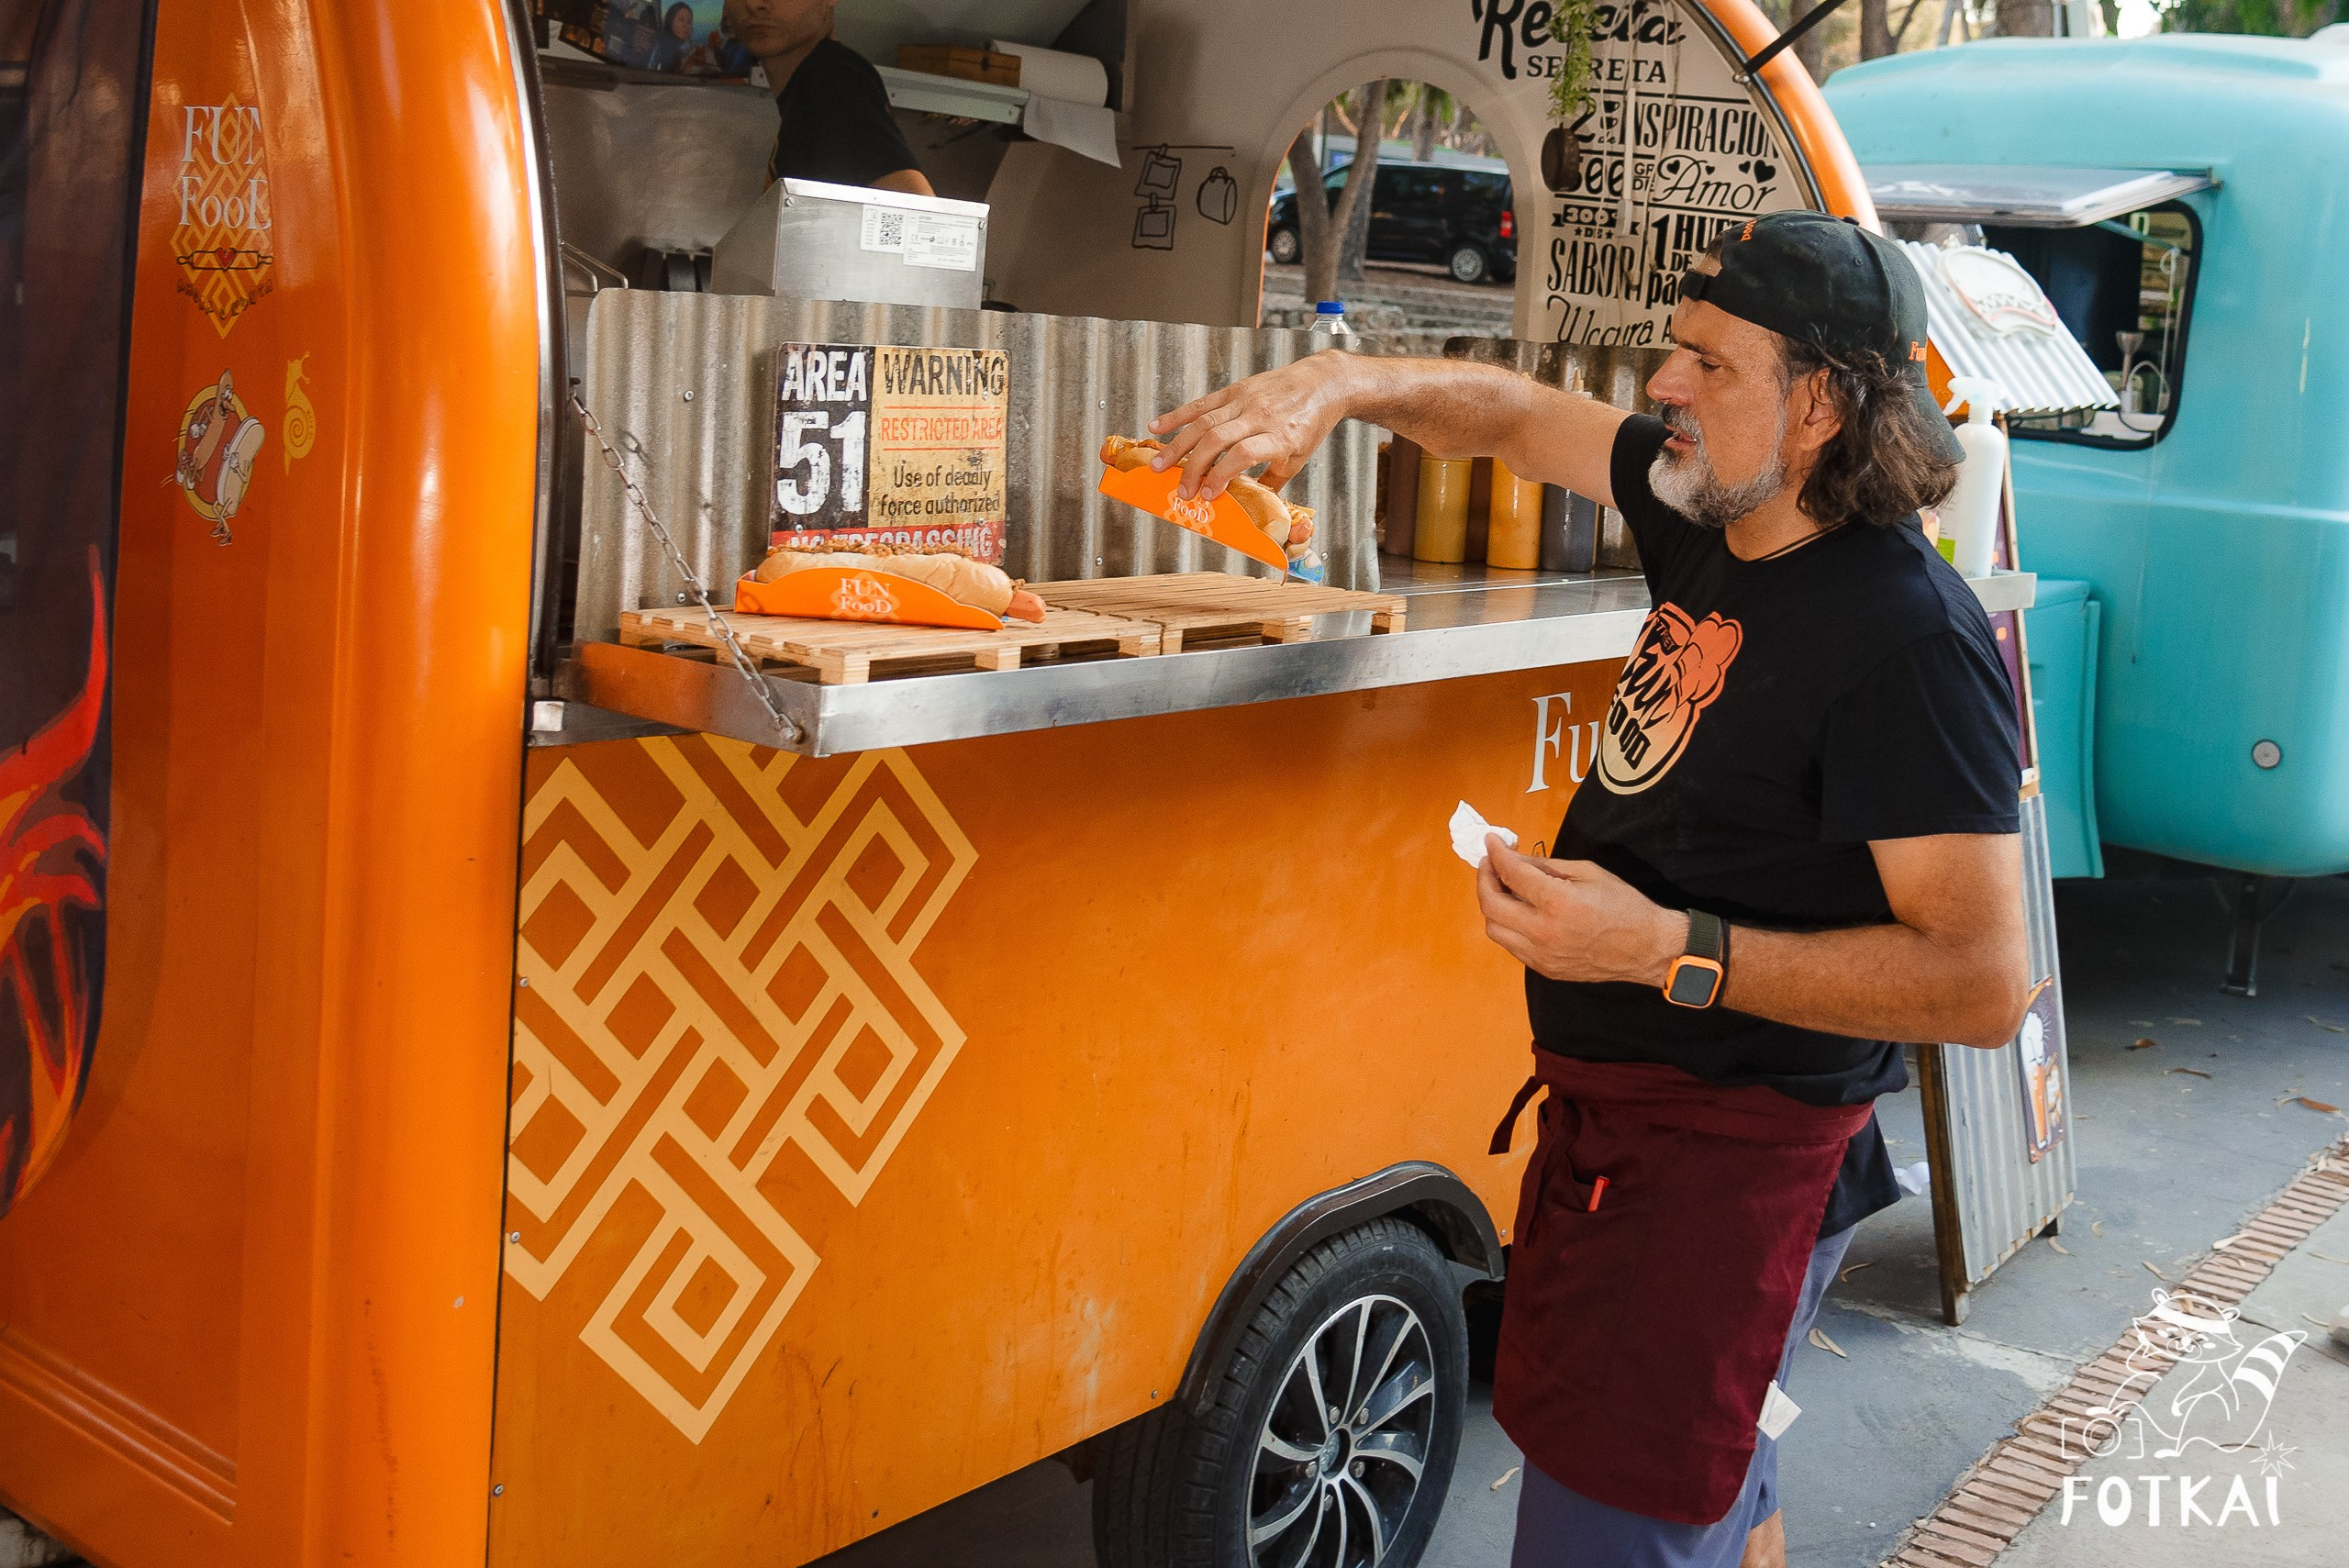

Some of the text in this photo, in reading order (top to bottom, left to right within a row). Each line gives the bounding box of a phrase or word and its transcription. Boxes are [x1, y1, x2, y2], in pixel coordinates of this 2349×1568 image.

[1653, 153, 1776, 211] Amor
[1652, 214, 1669, 270] 1
[781, 350, 1005, 402] AREA WARNING
[881, 417, 1003, 440] RESTRICTED AREA
[777, 410, 867, 516] 51
[894, 462, 992, 491] Use of deadly
[880, 489, 1001, 517] force authorized
[841, 577, 891, 597] FUN
